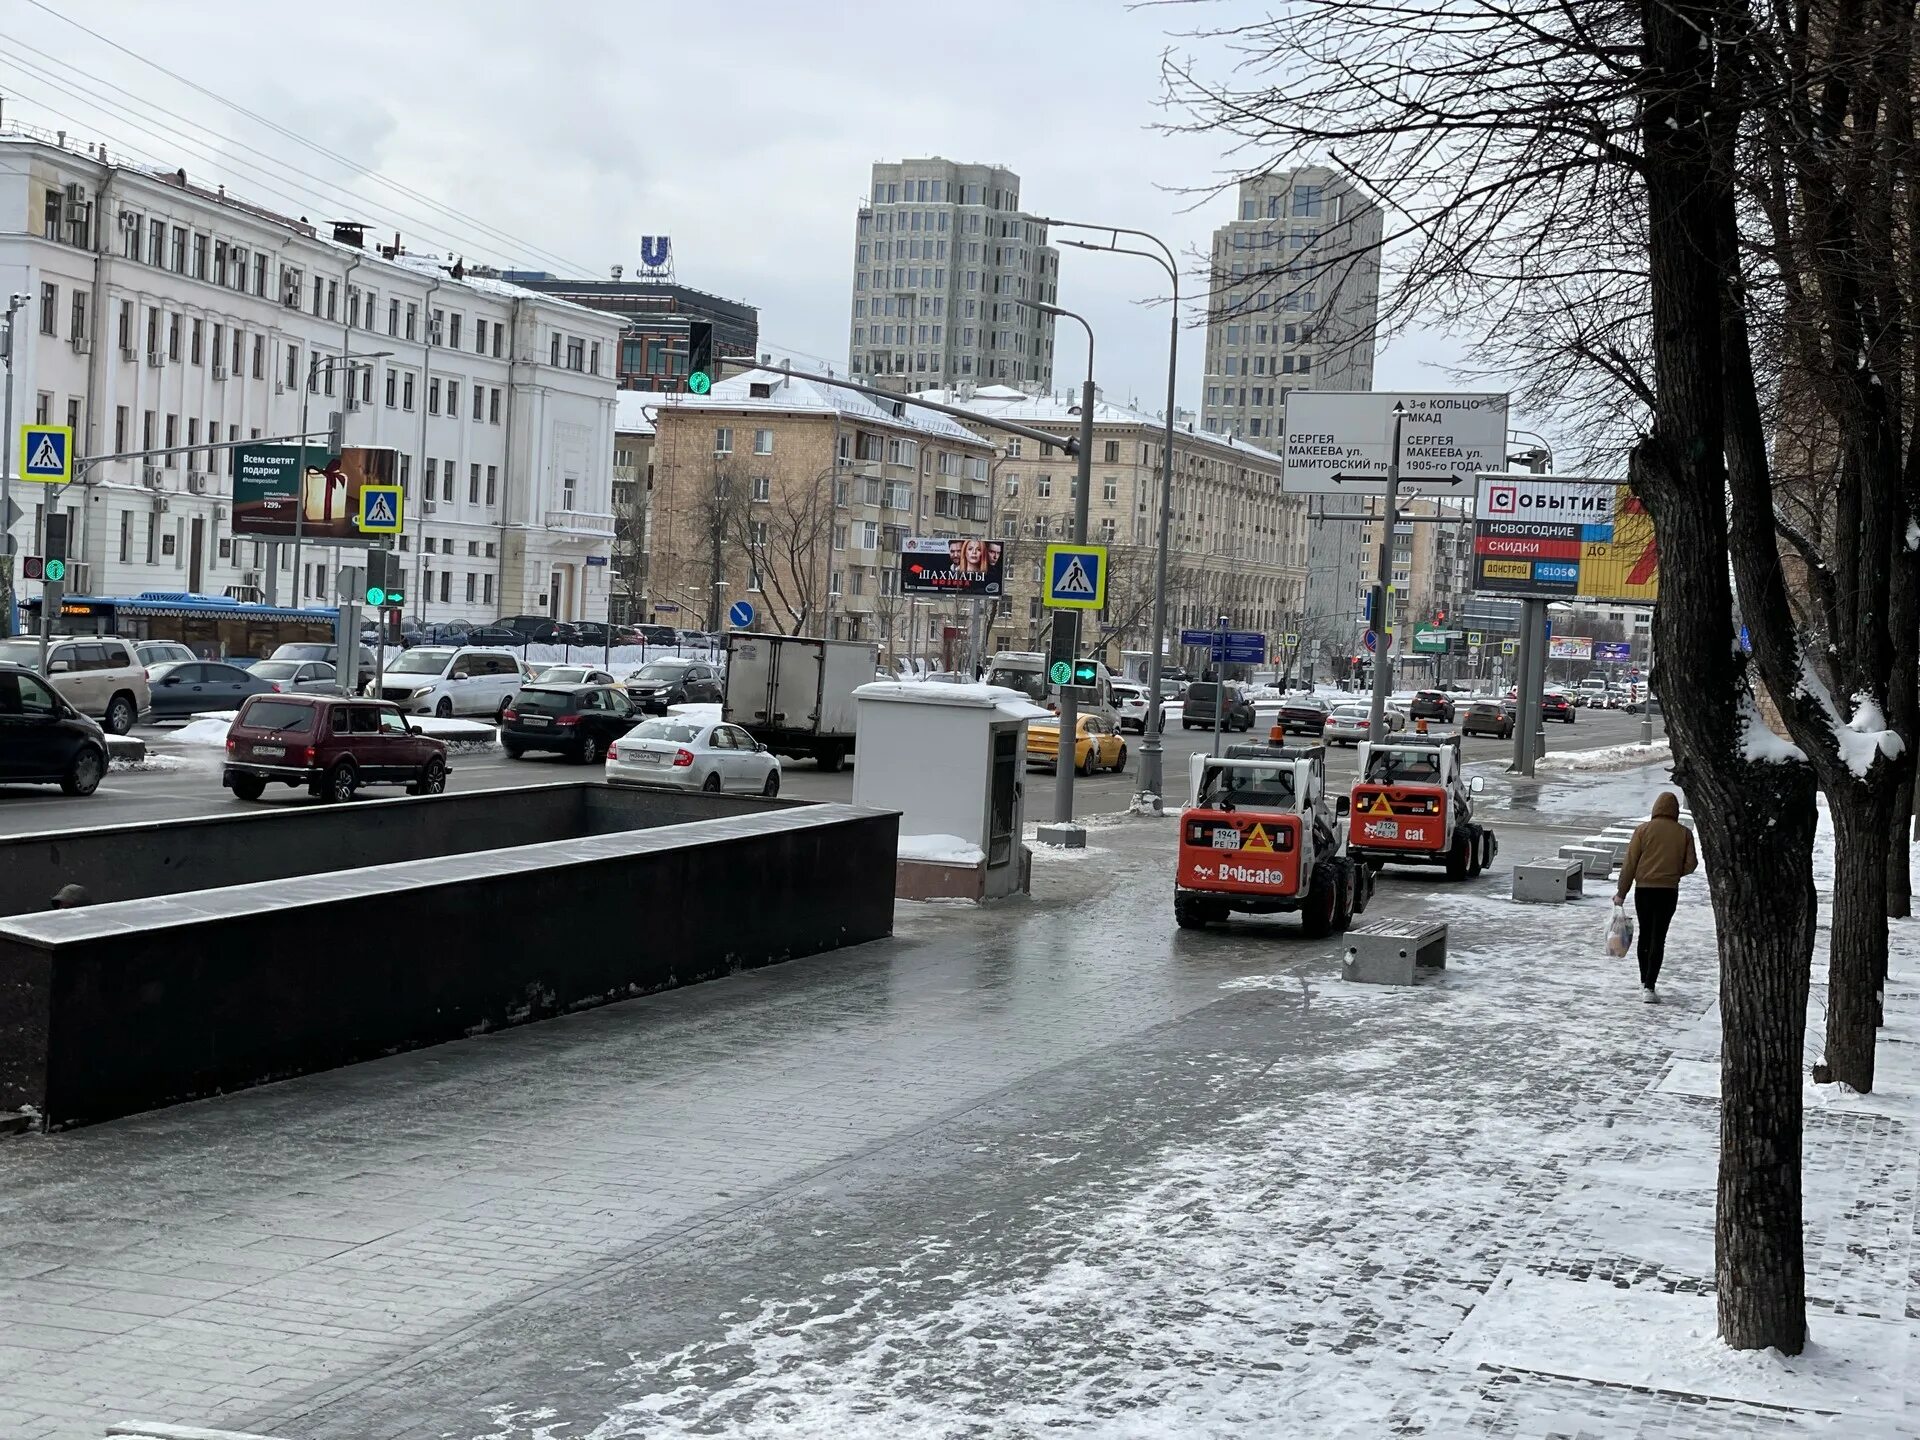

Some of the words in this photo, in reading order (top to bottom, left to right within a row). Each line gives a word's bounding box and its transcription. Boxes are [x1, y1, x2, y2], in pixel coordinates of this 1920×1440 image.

[1409, 399, 1426, 409] 3-е
[1429, 399, 1480, 411] КОЛЬЦО
[1408, 413, 1442, 424] МКАД
[1289, 434, 1335, 444] СЕРГЕЯ
[1407, 435, 1454, 445] СЕРГЕЯ
[1288, 445, 1343, 456] МАКЕЕВА
[1346, 448, 1363, 458] ул.
[1406, 447, 1463, 457] МАКЕЕВА
[1466, 450, 1483, 460] ул.
[243, 454, 265, 464] Всем
[266, 457, 295, 465] светят
[1288, 458, 1371, 469] ШМИТОВСКИЙ
[243, 466, 280, 477] подарки
[1406, 460, 1447, 471] 1905-го
[1450, 461, 1482, 472] ГОДА
[1485, 463, 1503, 473] ул.
[1495, 492, 1607, 511] СОБЫТИЕ
[1490, 523, 1575, 537] НОВОГОДНИЕ
[1488, 541, 1539, 554] СКИДКИ
[1587, 545, 1606, 557] ДО
[1487, 563, 1527, 575] ДОНСТРОЙ
[919, 569, 985, 582] ШАХМАТЫ
[1216, 830, 1237, 839] 1941
[1405, 828, 1424, 840] cat
[1219, 863, 1270, 884] Bobcat
